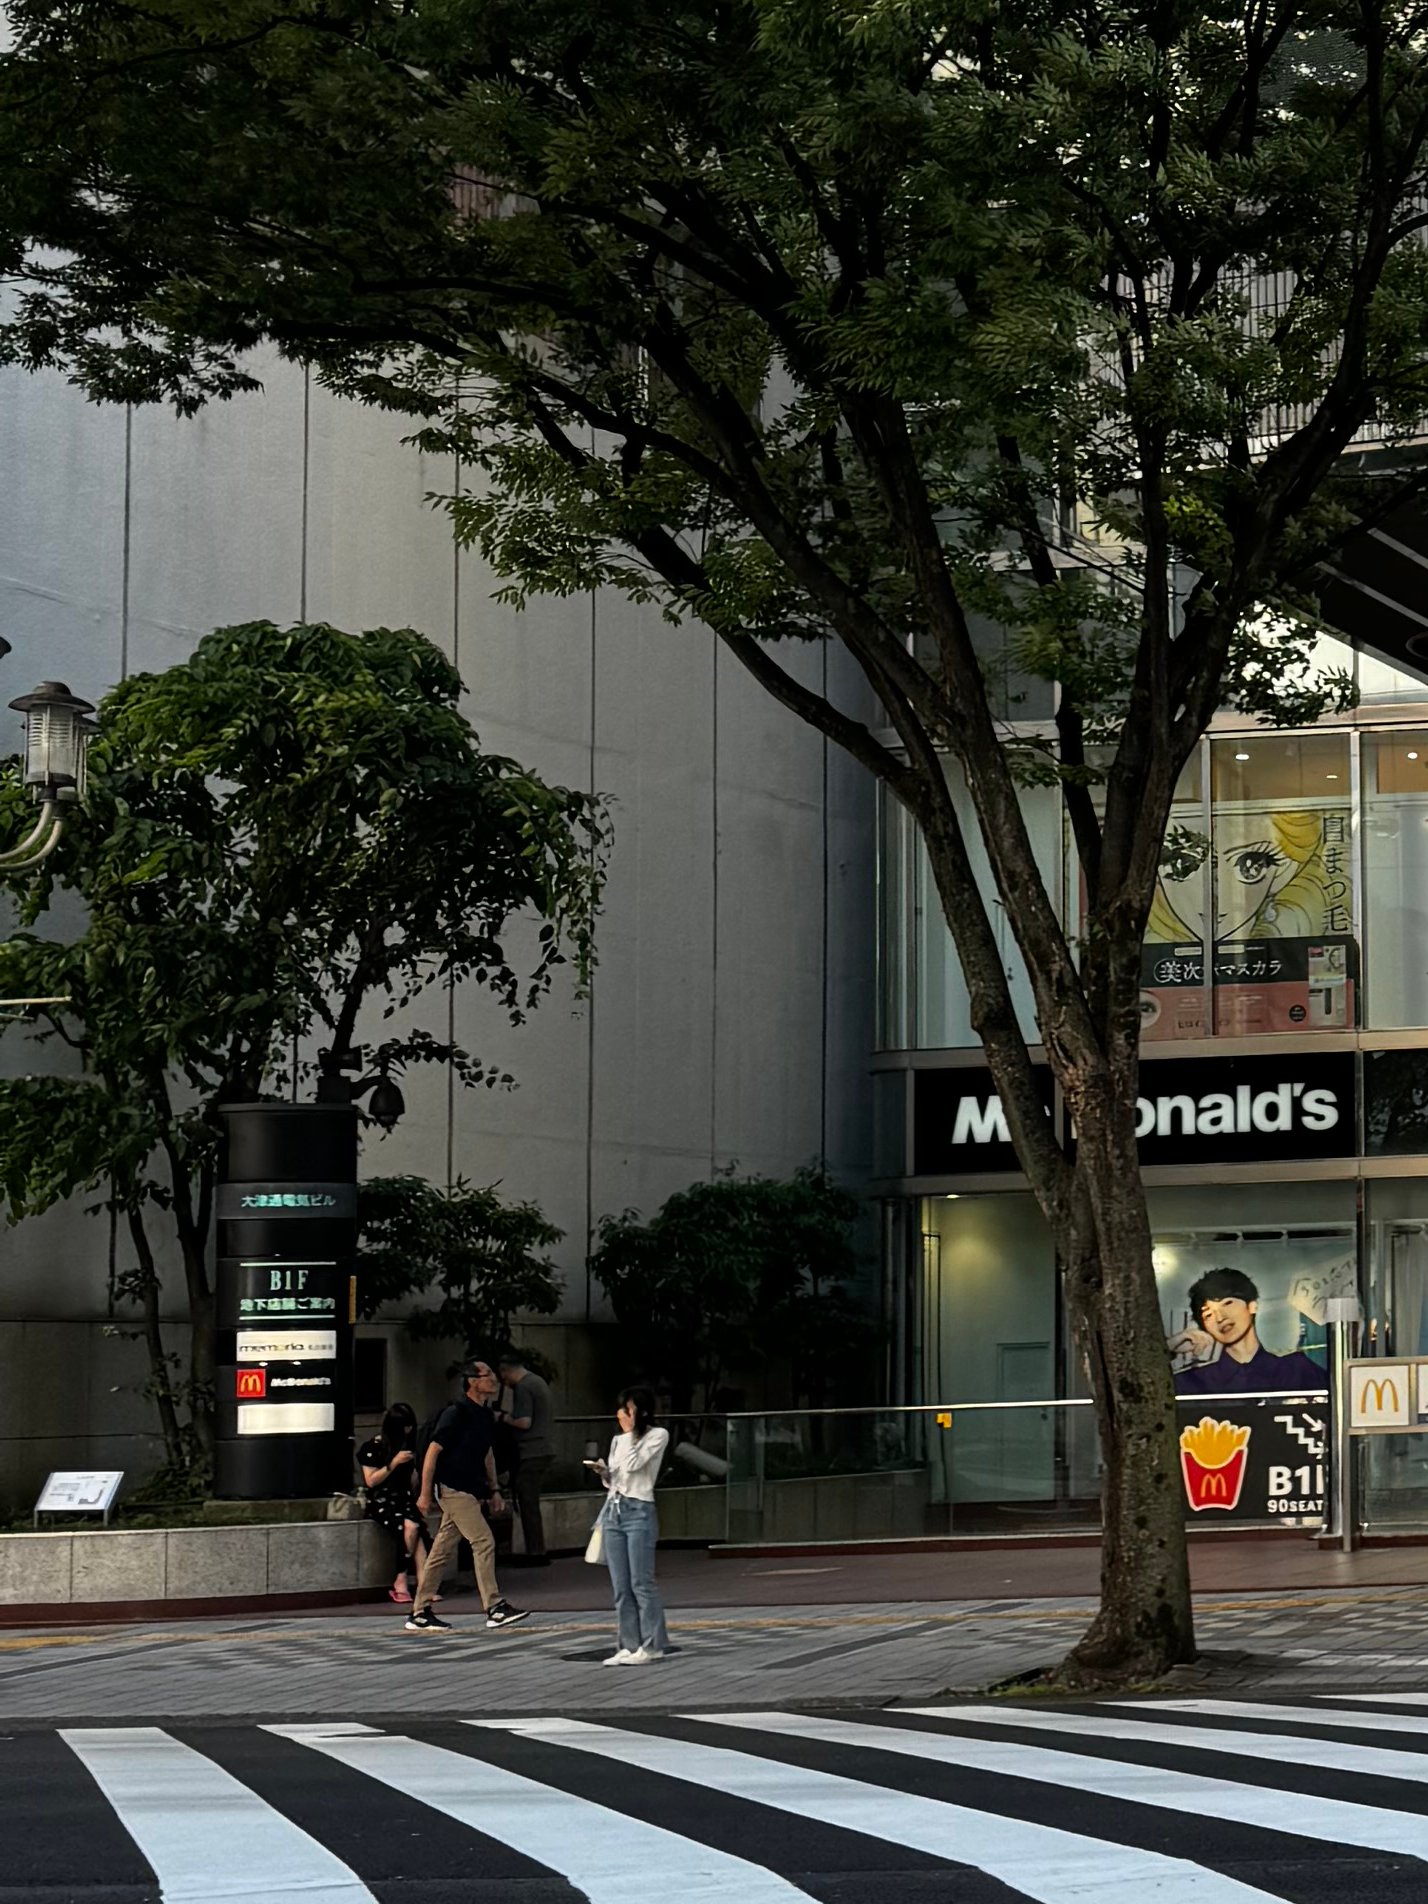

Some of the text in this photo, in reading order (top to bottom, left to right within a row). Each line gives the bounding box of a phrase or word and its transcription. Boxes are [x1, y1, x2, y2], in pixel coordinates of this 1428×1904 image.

[1322, 815, 1349, 934] 自まつ毛
[1157, 959, 1282, 984] 美次マスカラ
[951, 1082, 1339, 1144] Monald's
[270, 1269, 309, 1291] B1F
